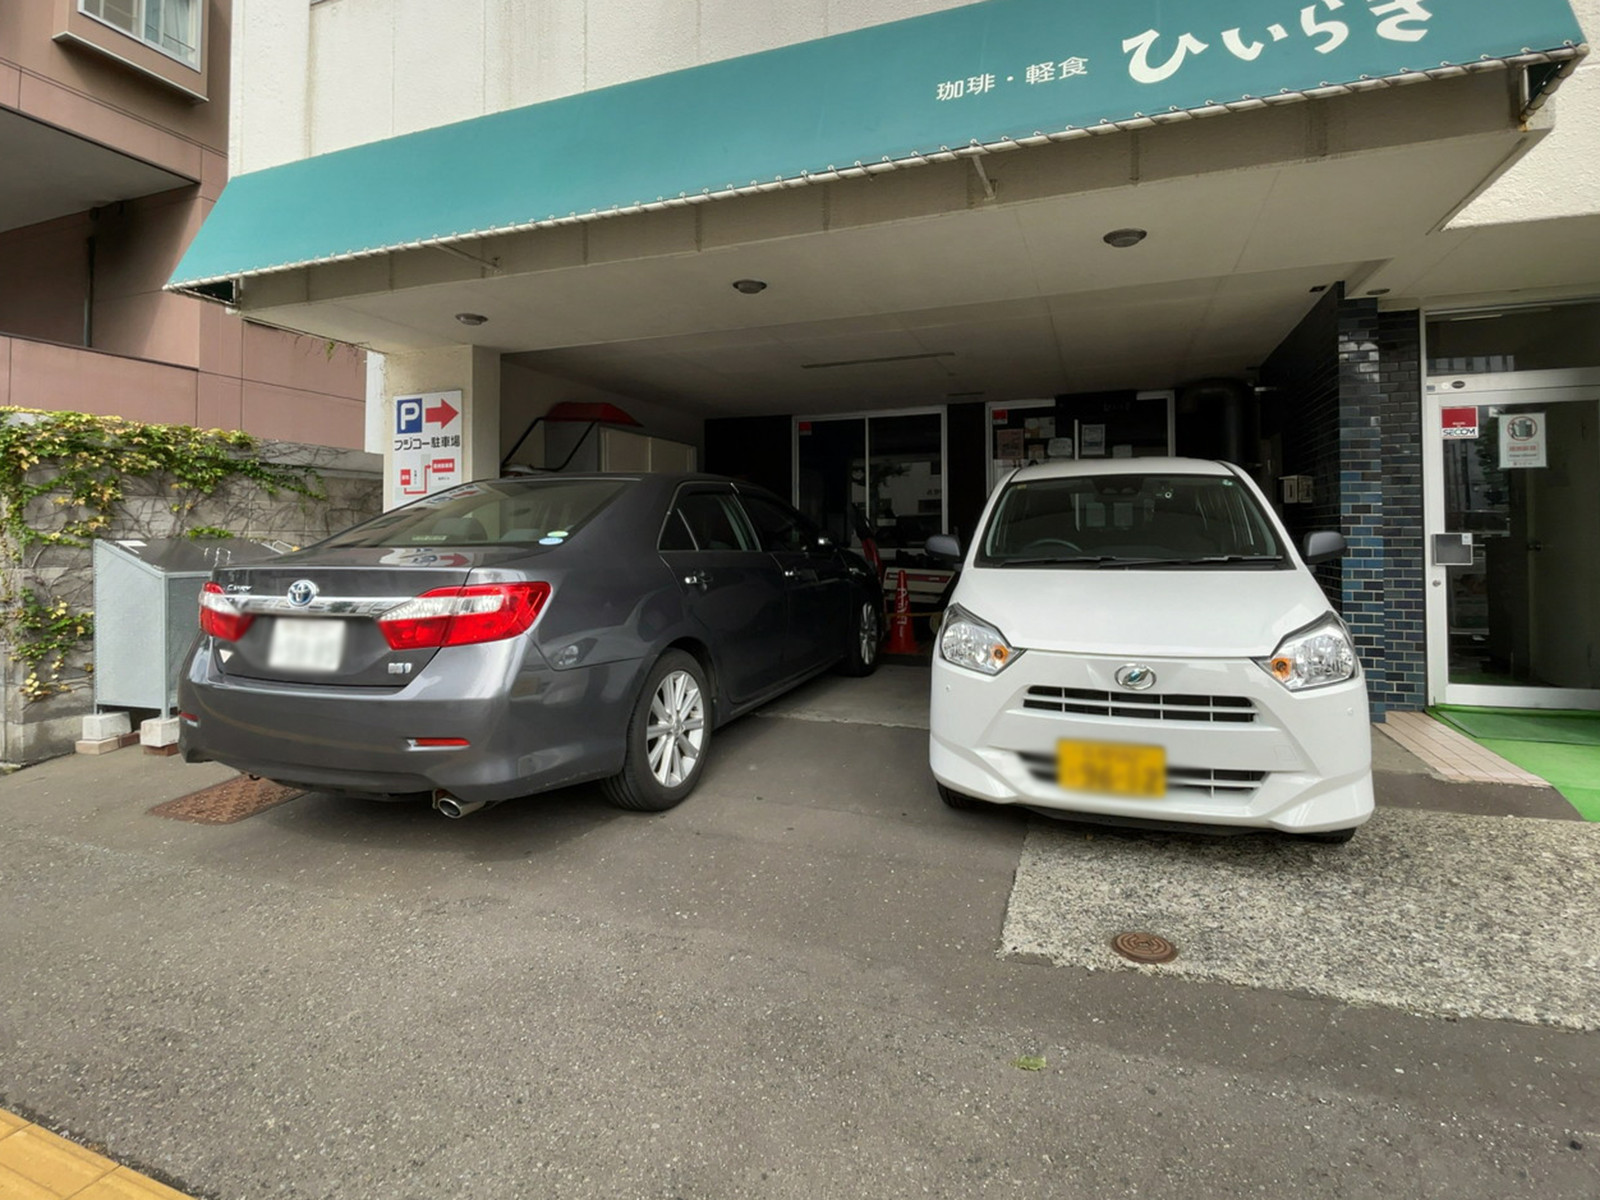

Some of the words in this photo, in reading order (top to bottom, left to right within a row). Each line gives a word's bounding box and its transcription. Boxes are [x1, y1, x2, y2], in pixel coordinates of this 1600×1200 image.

[936, 56, 1089, 102] 珈琲・軽食
[400, 402, 420, 430] P
[394, 435, 461, 451] フジコー駐車場
[1443, 428, 1475, 436] SECOM
